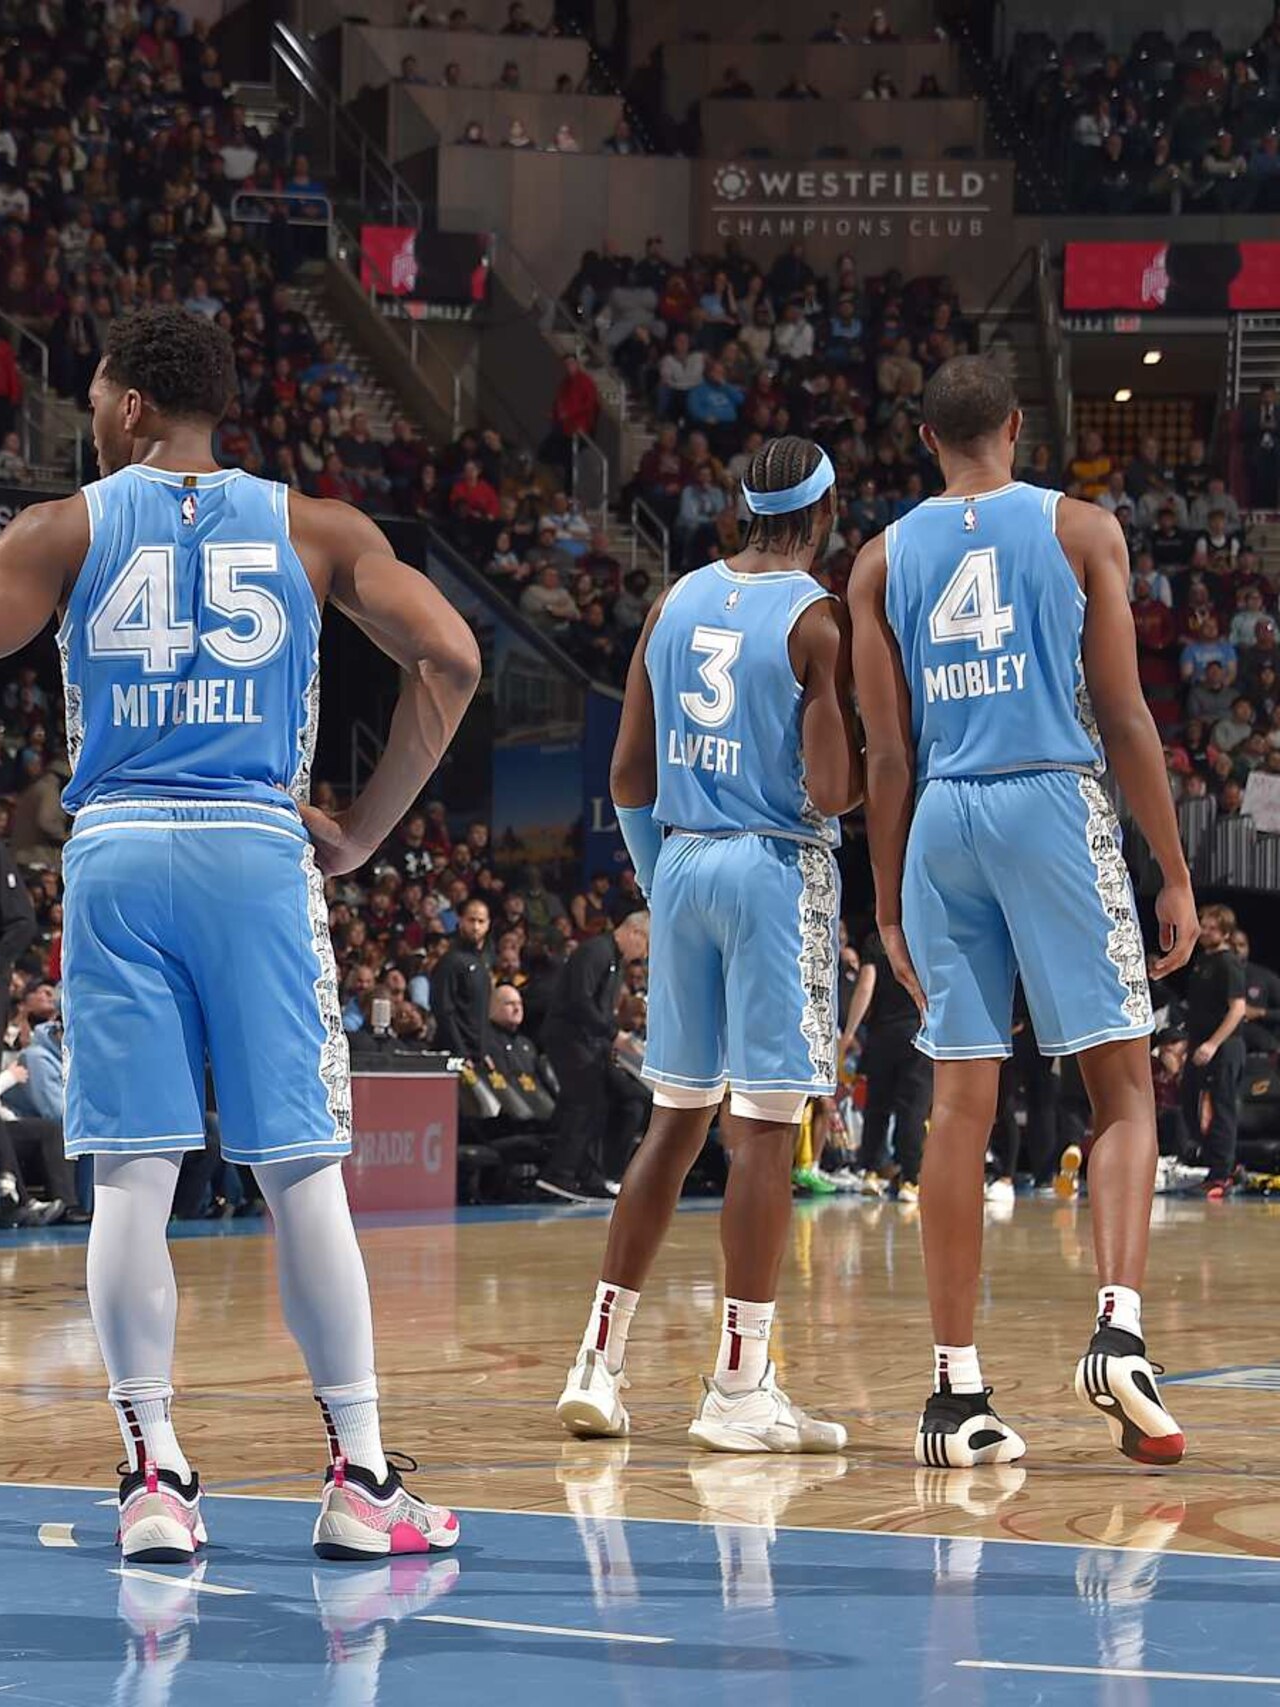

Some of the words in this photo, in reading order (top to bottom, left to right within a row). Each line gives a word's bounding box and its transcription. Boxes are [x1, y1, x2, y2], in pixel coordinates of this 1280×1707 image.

[759, 171, 984, 197] WESTFIELD
[717, 218, 892, 237] CHAMPIONS
[909, 218, 984, 237] CLUB
[86, 543, 287, 673] 45
[928, 547, 1015, 652] 4
[679, 625, 744, 728] 3
[923, 652, 1027, 704] MOBLEY
[111, 679, 263, 728] MITCHELL
[667, 729, 742, 777] LVERT
